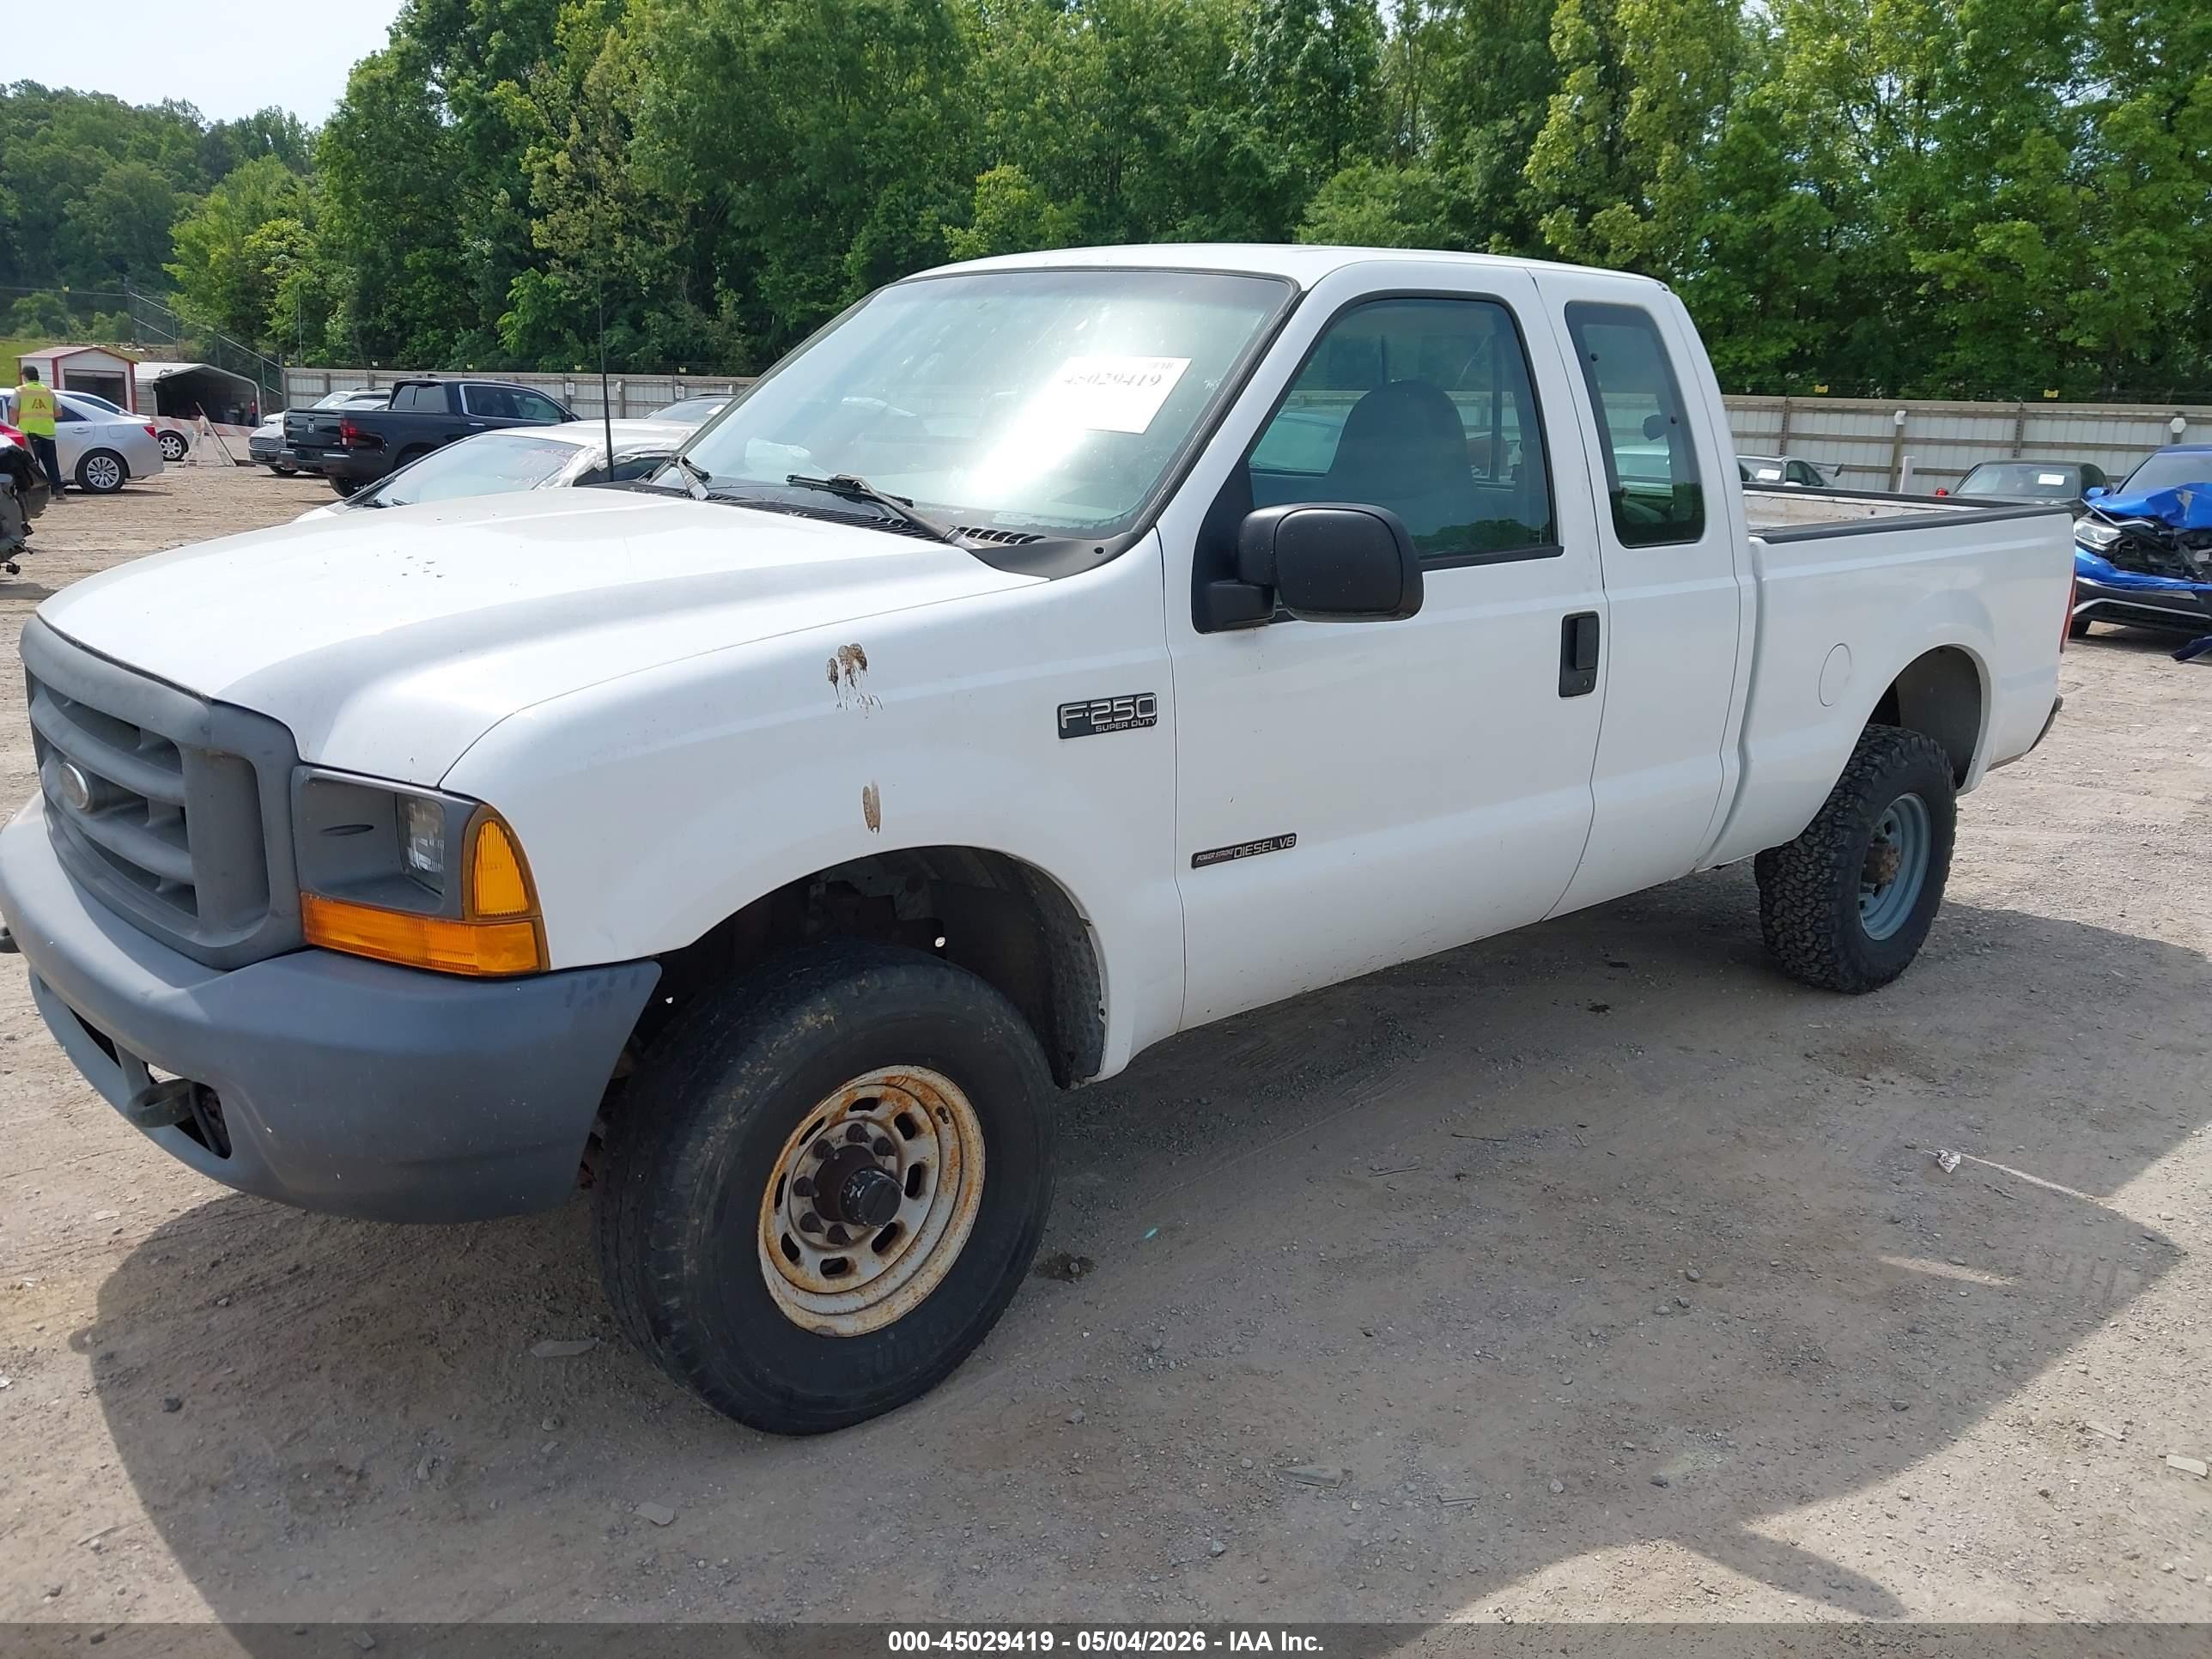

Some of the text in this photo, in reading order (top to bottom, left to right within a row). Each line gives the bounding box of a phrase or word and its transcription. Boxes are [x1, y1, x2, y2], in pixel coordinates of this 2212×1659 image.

[1095, 717, 1156, 732] SUPER DUTY
[1196, 852, 1215, 862] POWER
[1234, 841, 1278, 859] DIESEL
[1279, 836, 1295, 848] V8
